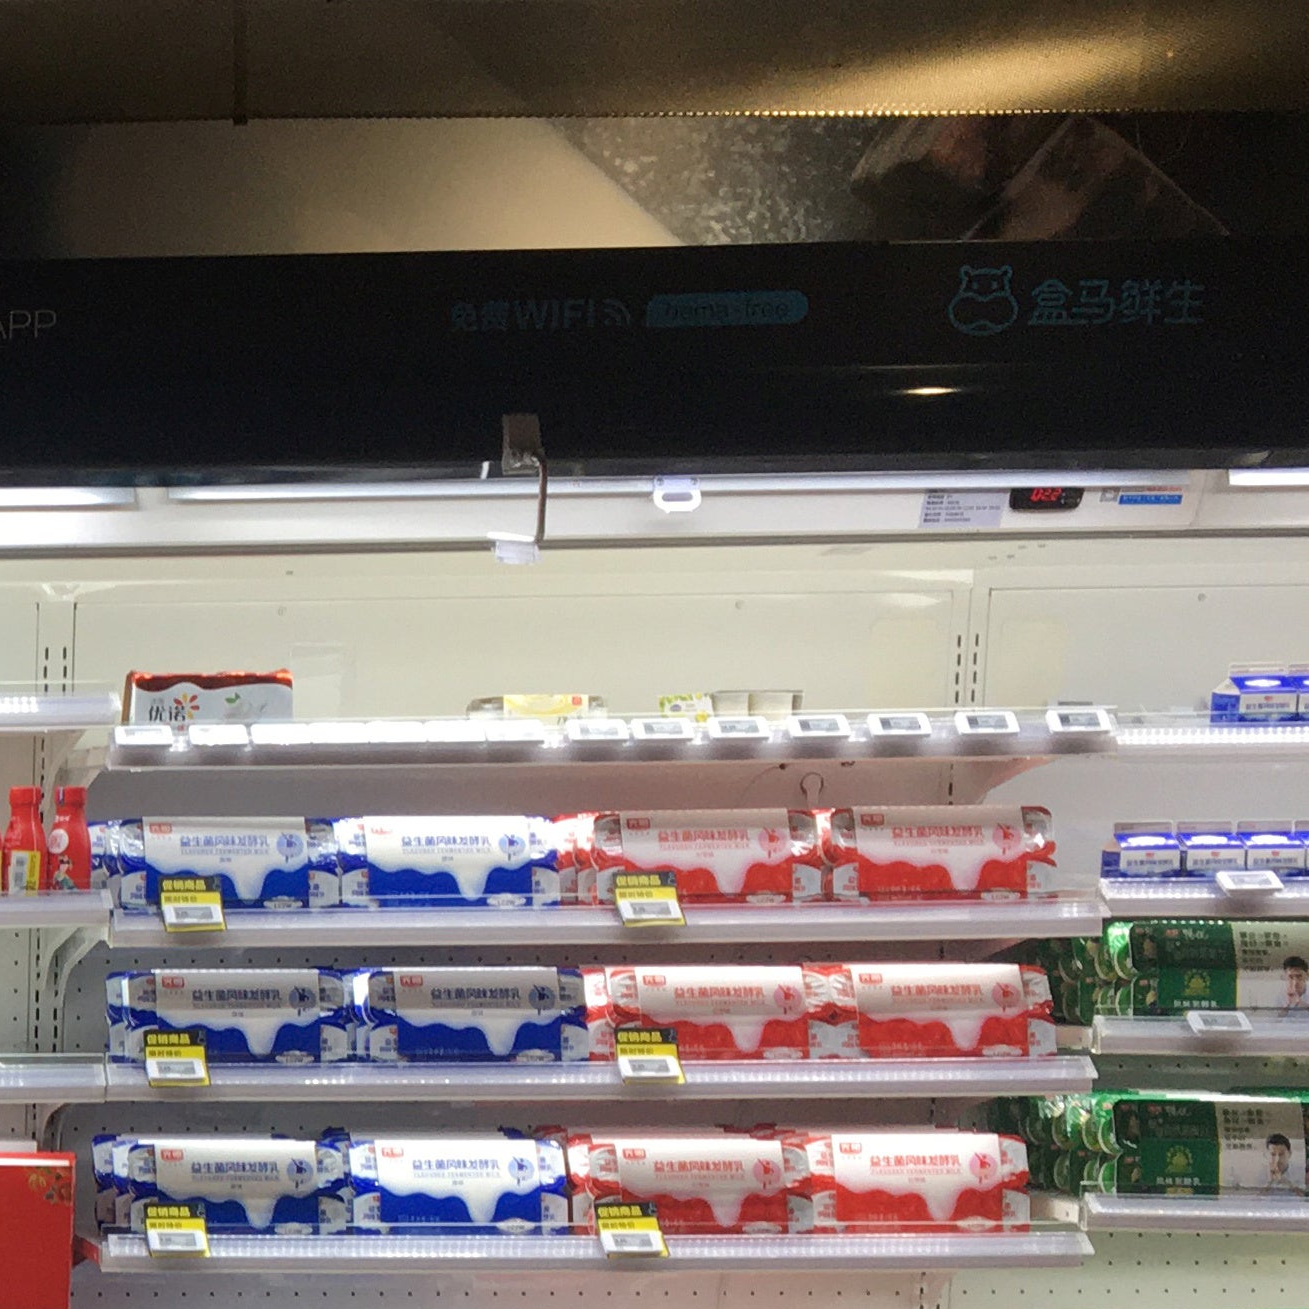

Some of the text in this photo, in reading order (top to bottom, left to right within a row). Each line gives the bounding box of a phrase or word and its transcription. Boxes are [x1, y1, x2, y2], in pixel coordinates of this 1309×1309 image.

[1028, 278, 1205, 328] 盒马鲜生
[180, 835, 269, 846] 益生菌风味发酵乳
[401, 835, 490, 846] 益生菌风味发酵乳
[192, 989, 281, 1001] 益生菌风味发酵乳
[431, 989, 520, 1000] 益生菌风味发酵乳
[192, 1161, 280, 1173] 益生菌风味发酵乳
[413, 1159, 500, 1171] 益生菌风味发酵乳
